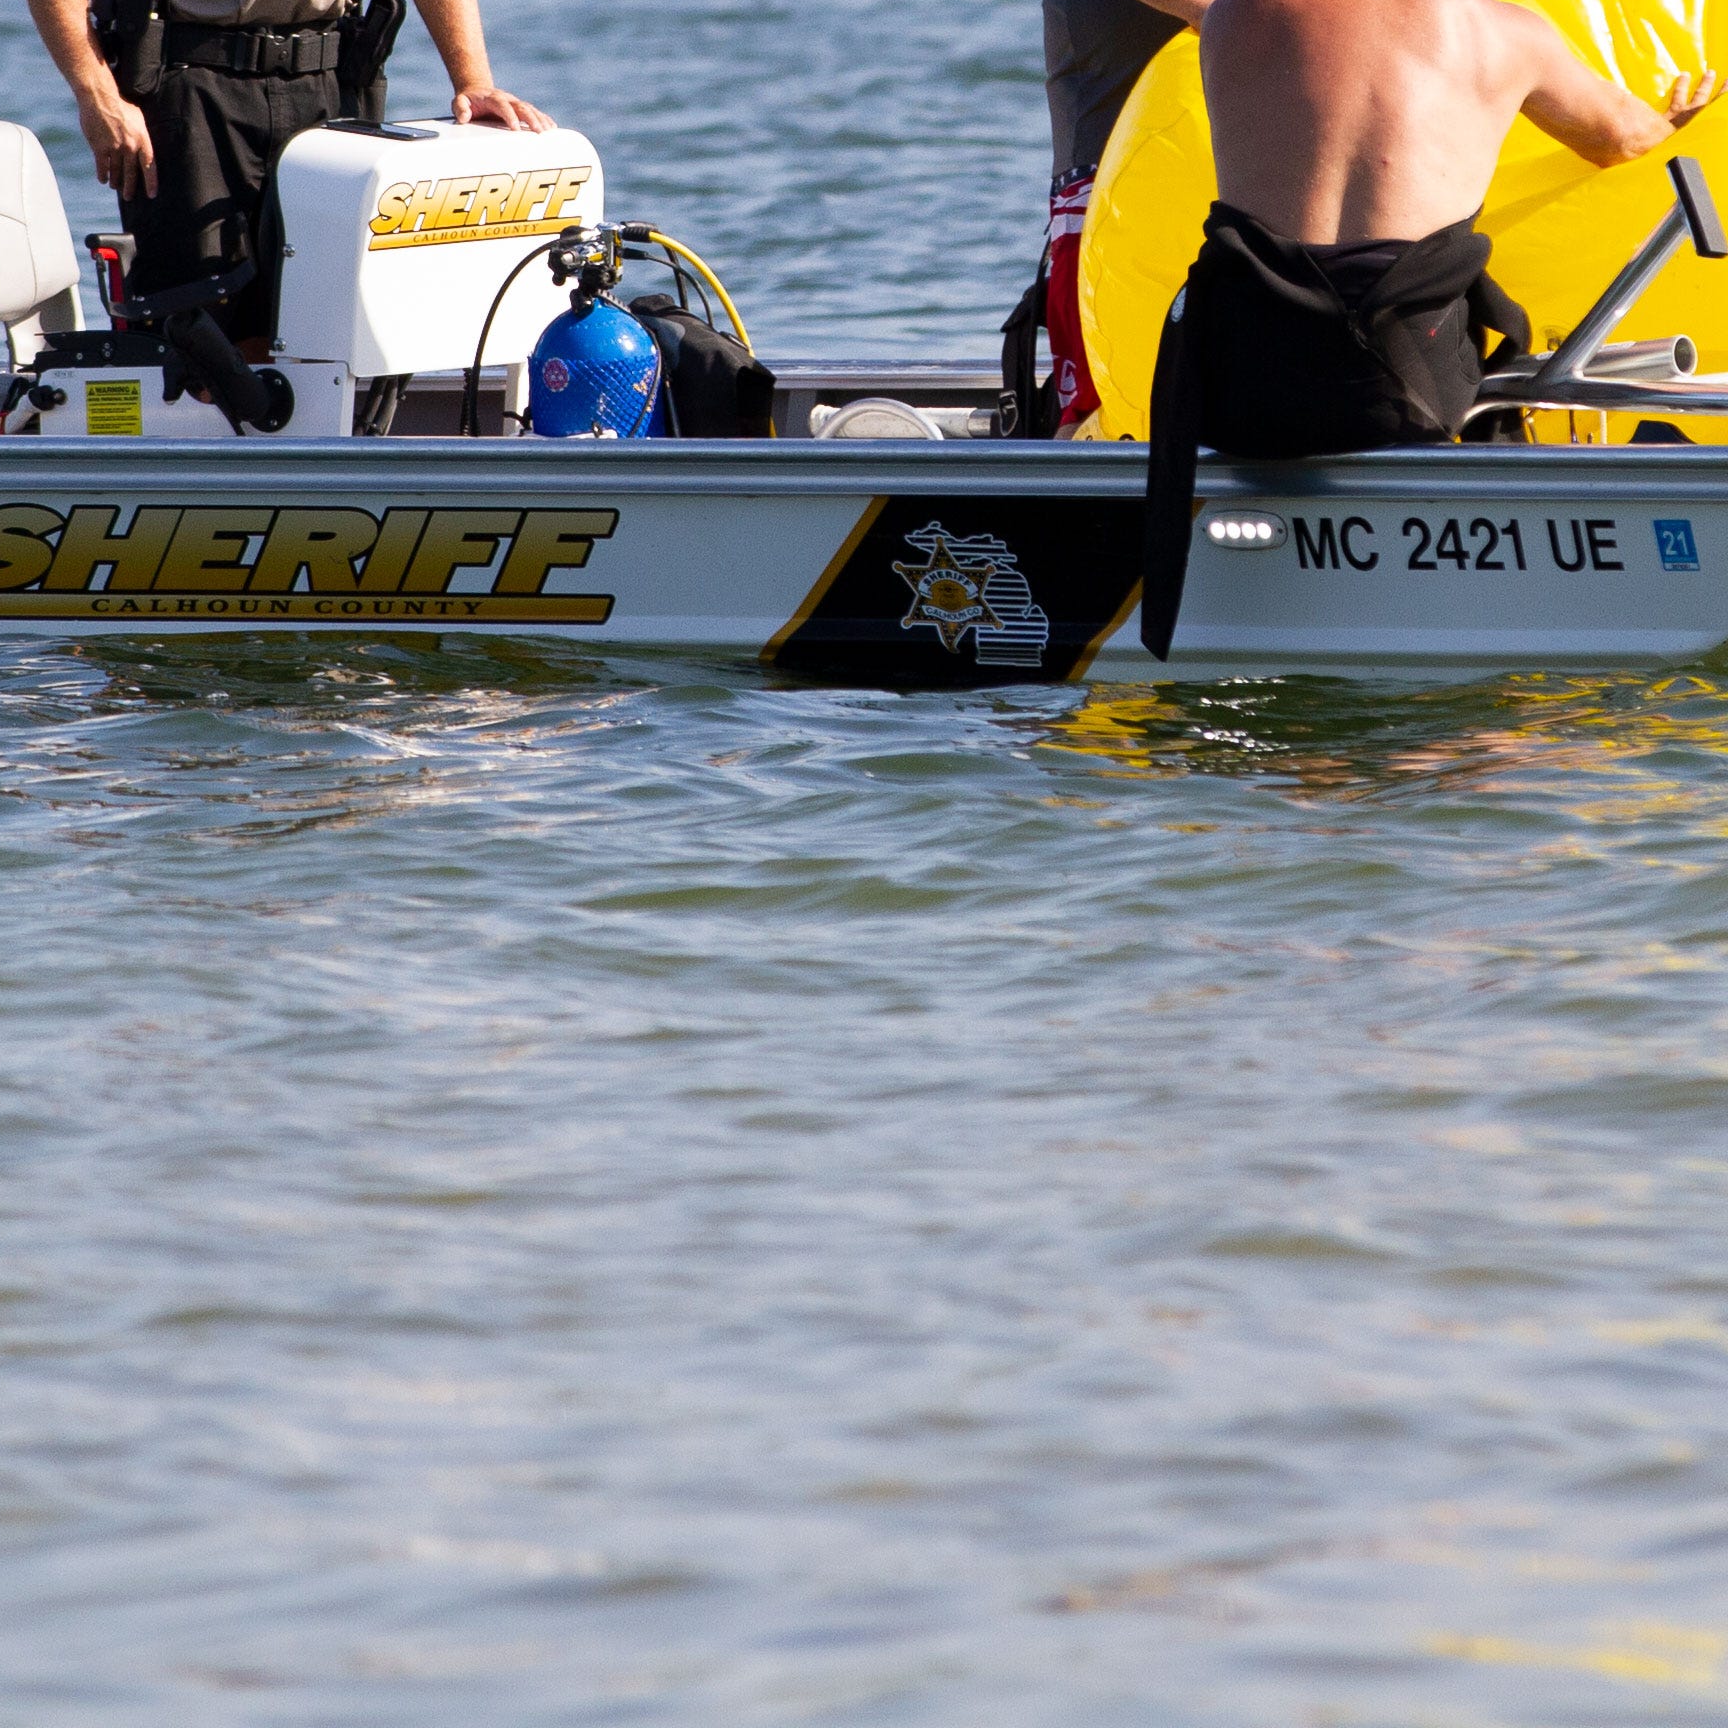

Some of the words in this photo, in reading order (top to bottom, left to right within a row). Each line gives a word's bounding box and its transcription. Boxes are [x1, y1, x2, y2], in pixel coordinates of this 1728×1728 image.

[368, 166, 592, 235] SHERIFF
[413, 230, 477, 243] CALHOUN
[485, 224, 538, 237] COUNTY
[1293, 517, 1379, 571] MC
[1402, 517, 1527, 571] 2421
[1548, 519, 1625, 572] UE
[1663, 530, 1689, 555] 21
[923, 570, 972, 586] SHERIFF
[91, 598, 292, 615] CALHOUN
[314, 600, 484, 616] COUNTY
